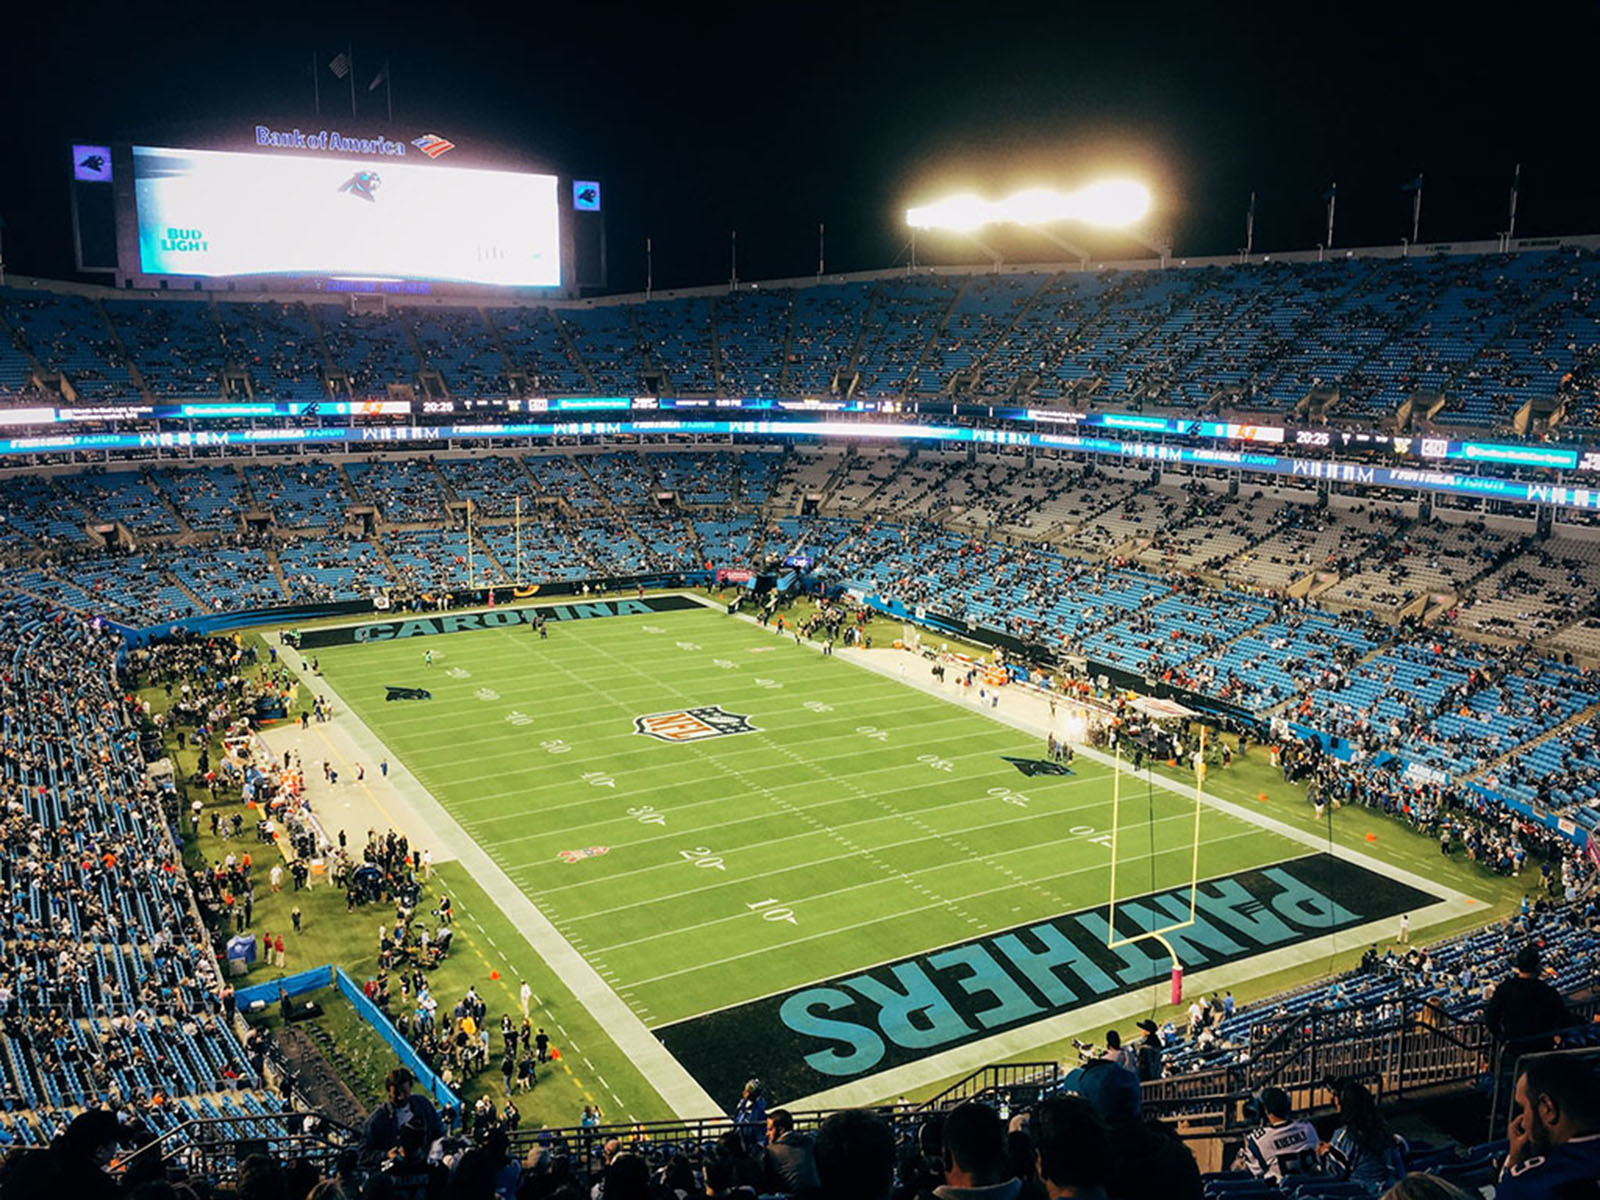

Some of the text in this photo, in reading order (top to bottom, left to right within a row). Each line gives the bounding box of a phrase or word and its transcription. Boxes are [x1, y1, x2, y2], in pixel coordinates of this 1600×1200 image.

[255, 125, 406, 155] Bank of America
[167, 228, 202, 240] BUD
[161, 239, 208, 252] LIGHT
[1296, 431, 1330, 446] 20:25
[354, 599, 656, 642] CAROLINA
[646, 713, 713, 739] NFL
[987, 787, 1031, 805] 20
[626, 805, 665, 824] 30
[1069, 826, 1113, 844] 10
[680, 846, 724, 869] 20
[746, 898, 795, 923] 10
[779, 866, 1365, 1076] PANTHERS
